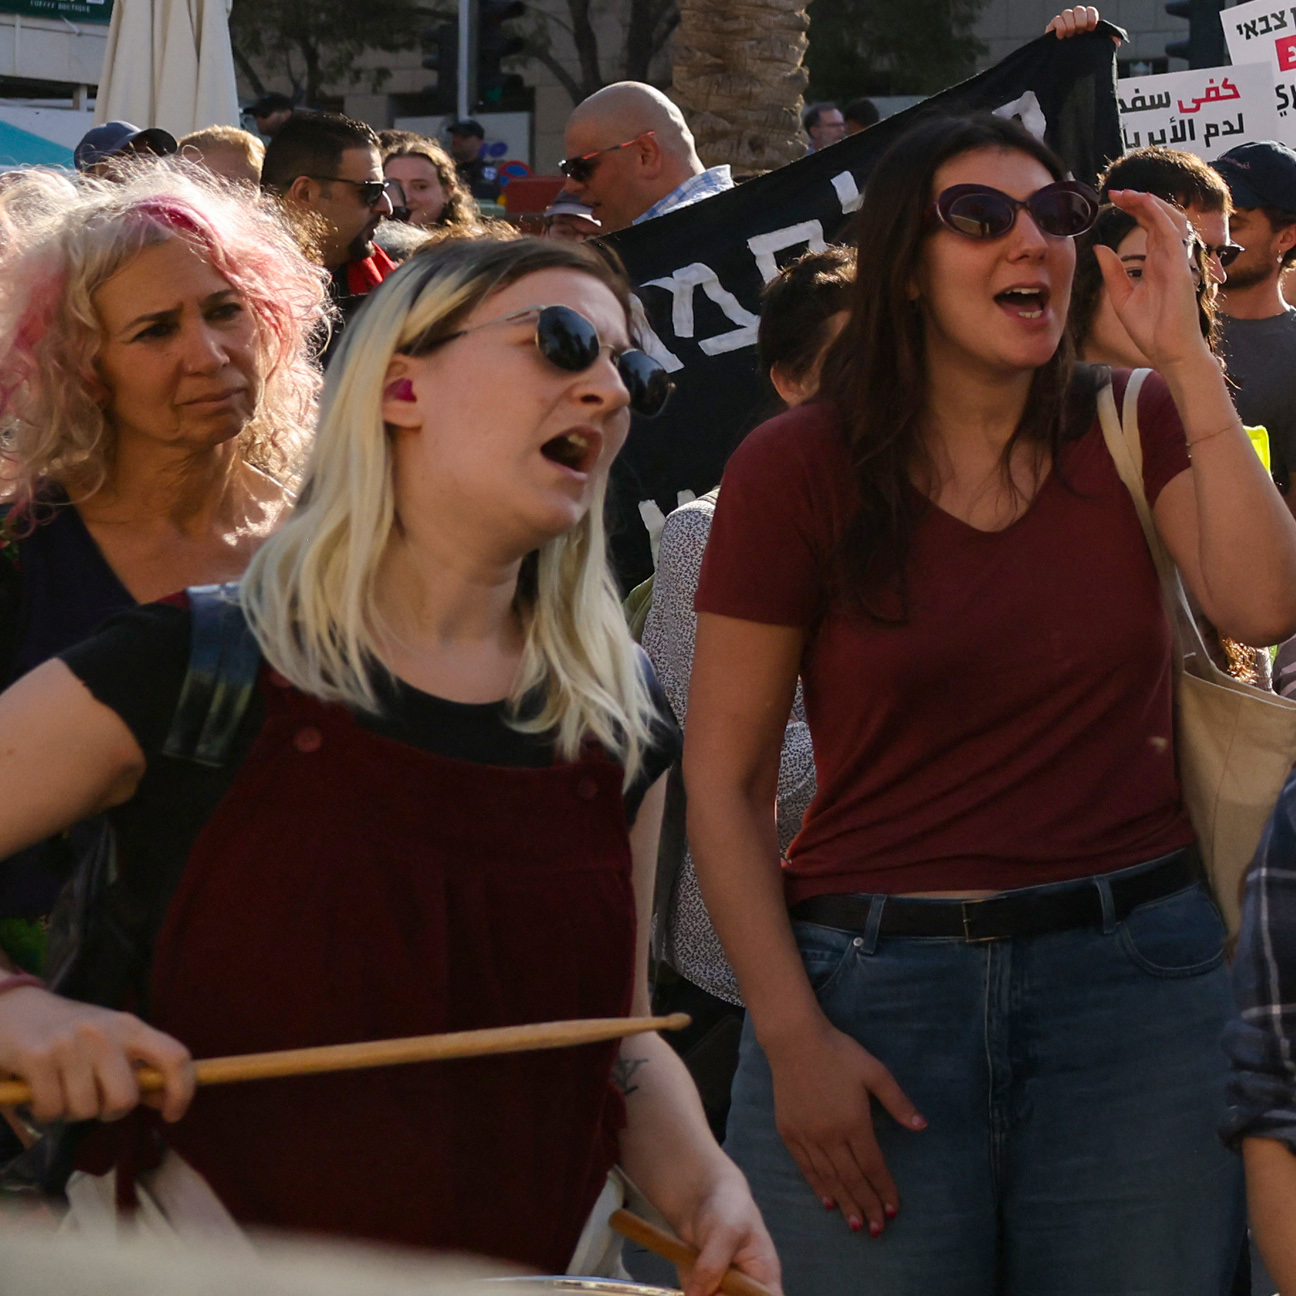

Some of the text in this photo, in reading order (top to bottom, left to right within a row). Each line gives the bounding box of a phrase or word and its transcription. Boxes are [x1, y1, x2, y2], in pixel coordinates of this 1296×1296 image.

[1236, 10, 1288, 41] צבאי
[1177, 77, 1242, 114] كفى
[1203, 112, 1245, 148] لدم
